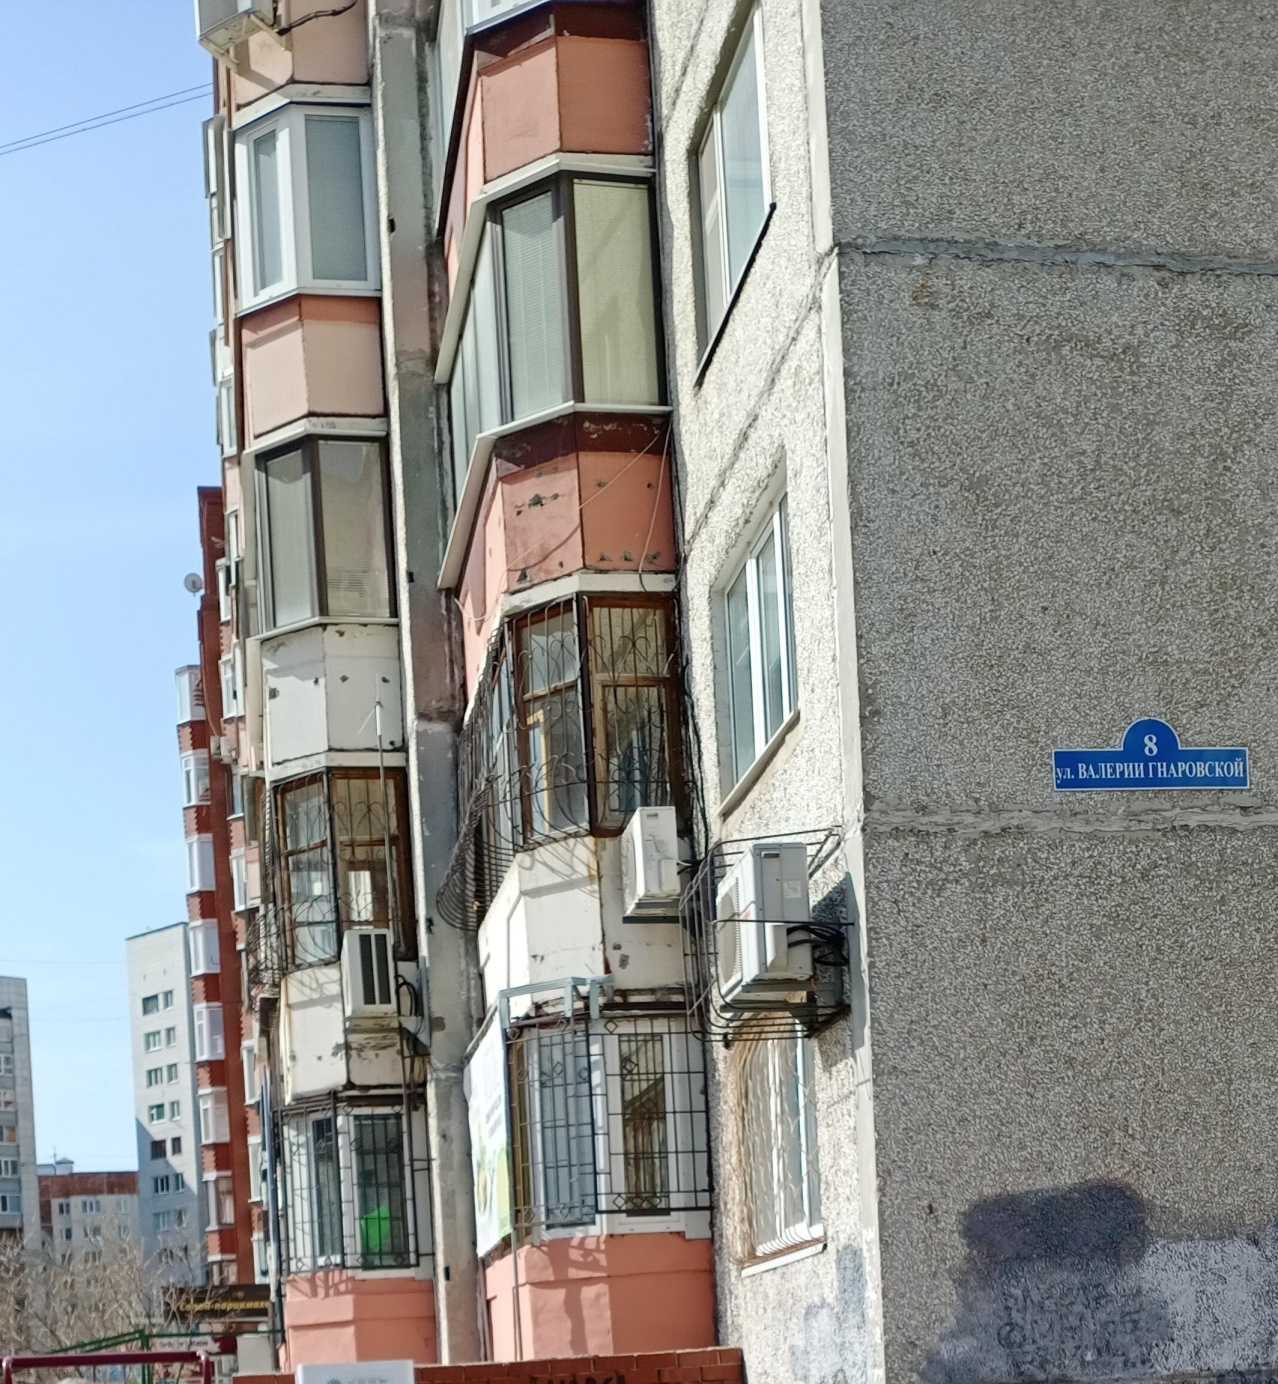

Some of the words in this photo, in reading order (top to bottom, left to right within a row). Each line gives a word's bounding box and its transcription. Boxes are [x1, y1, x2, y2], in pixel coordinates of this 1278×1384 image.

[1143, 734, 1158, 756] 8
[1056, 765, 1075, 783] ул.
[1078, 762, 1144, 779] ВАЛЕРИИ
[1148, 758, 1244, 778] ГНАРОВСКОЙ
